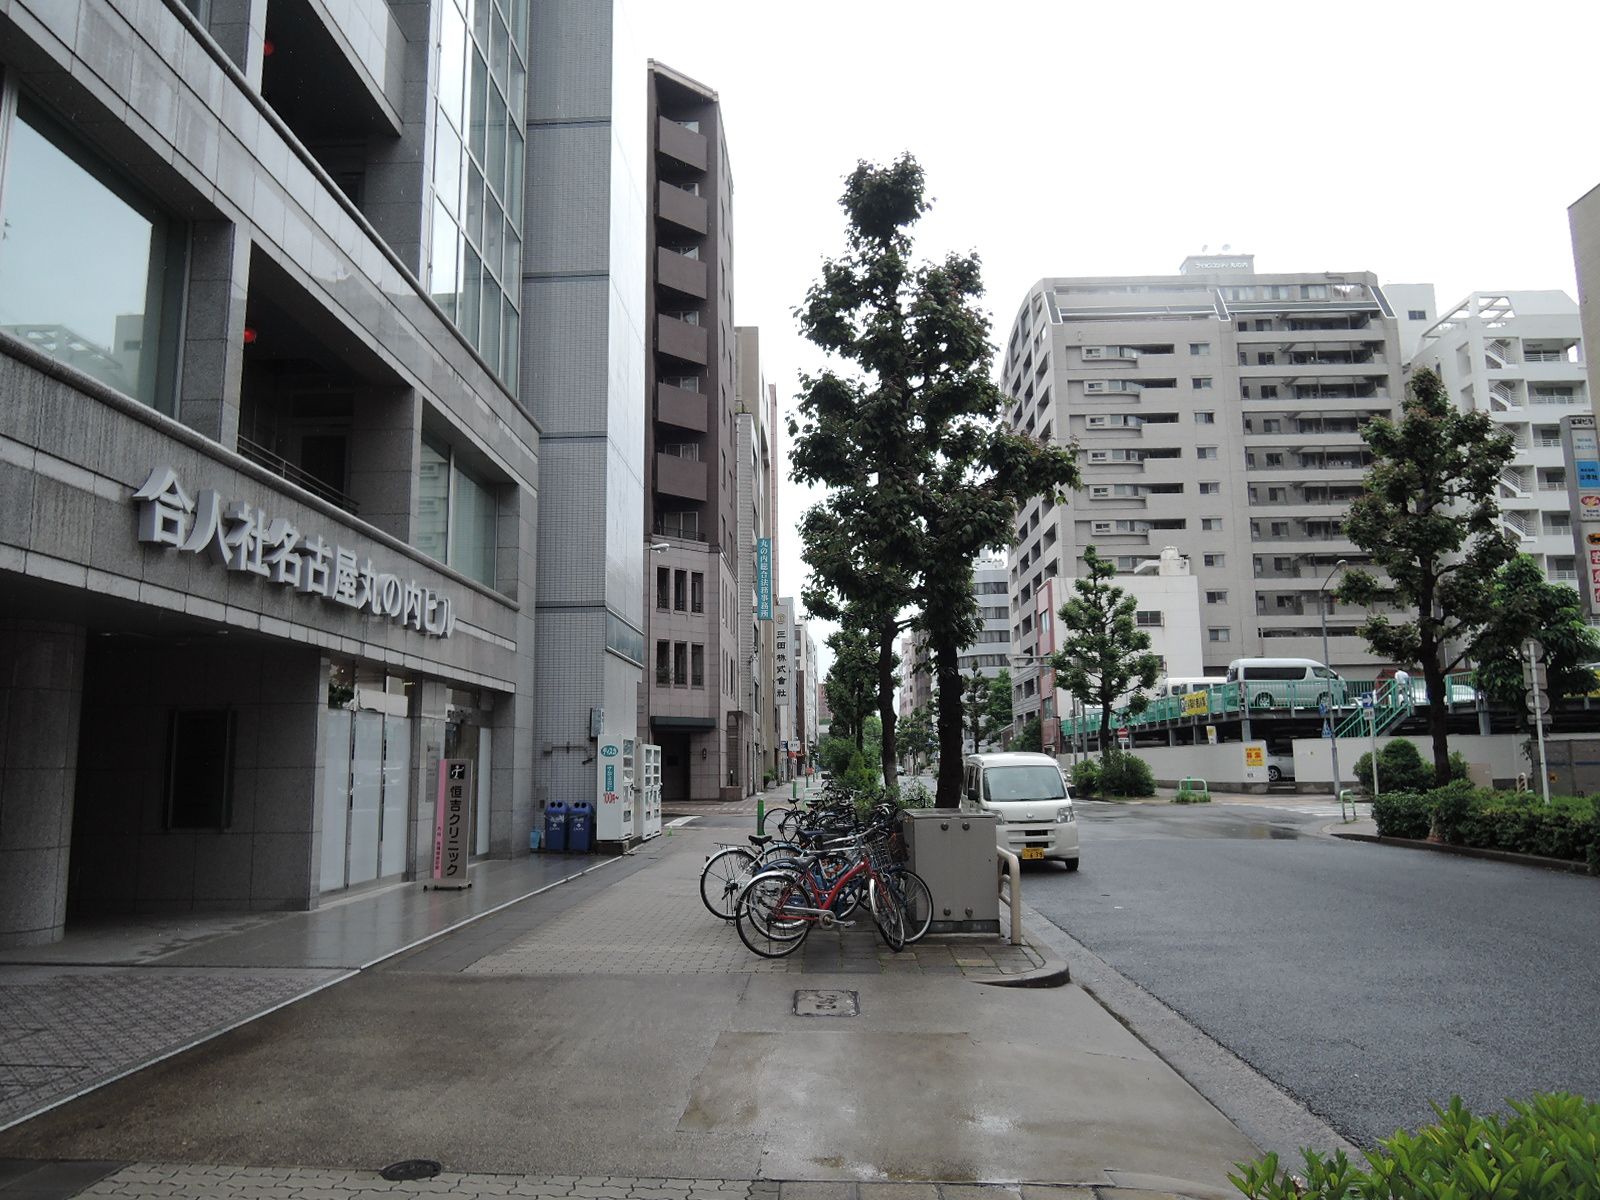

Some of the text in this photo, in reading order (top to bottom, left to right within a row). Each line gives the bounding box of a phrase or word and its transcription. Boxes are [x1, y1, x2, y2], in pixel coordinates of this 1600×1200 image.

[132, 464, 456, 638] 合人社名古屋丸の内ビル
[760, 540, 770, 617] 丸の内総合法務事務所
[447, 785, 462, 876] 恒吉クリニック
